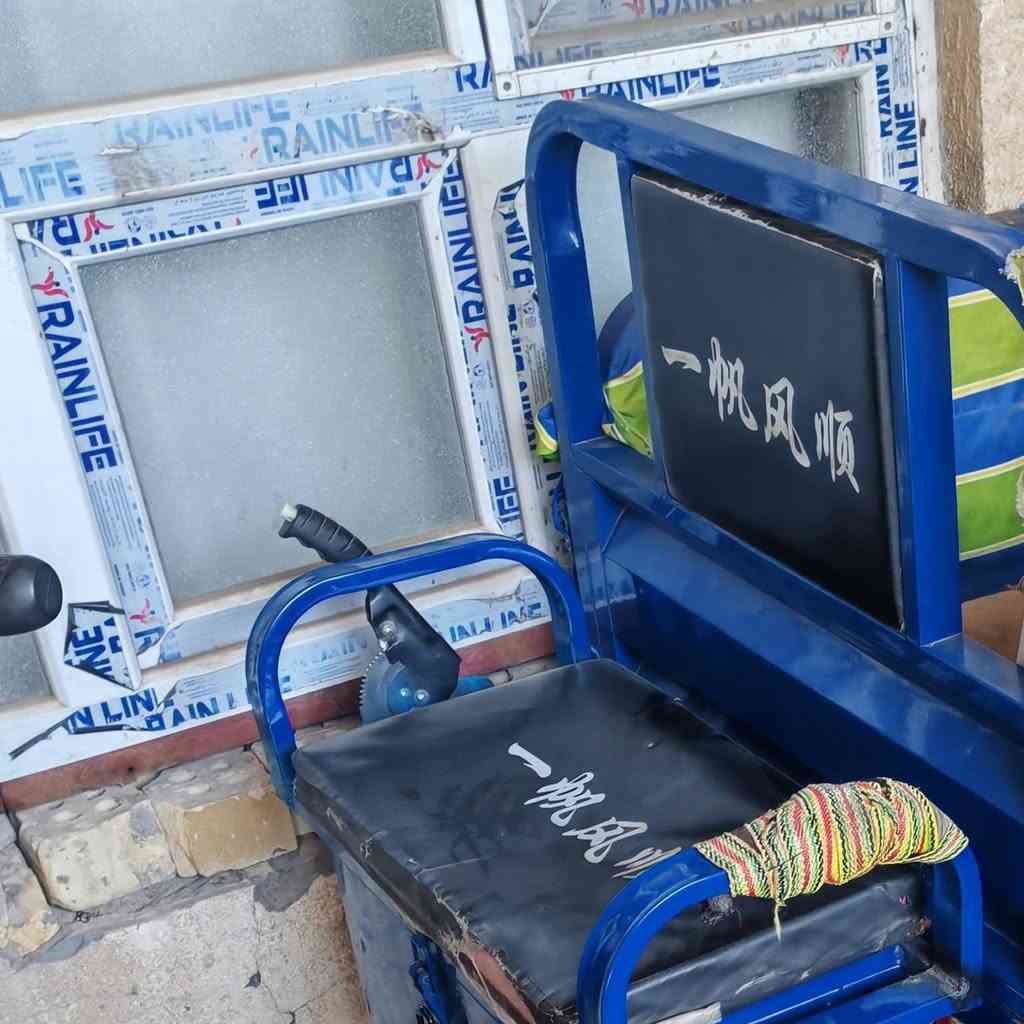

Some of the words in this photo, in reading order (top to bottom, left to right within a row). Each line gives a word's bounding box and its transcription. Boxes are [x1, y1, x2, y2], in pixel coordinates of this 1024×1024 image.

[261, 101, 424, 163] RAINLIF
[895, 101, 920, 170] LINE
[441, 159, 487, 325] RAINLIFE
[37, 299, 118, 473] RAINLIFE
[72, 625, 114, 677] INE
[101, 688, 160, 723] LIN
